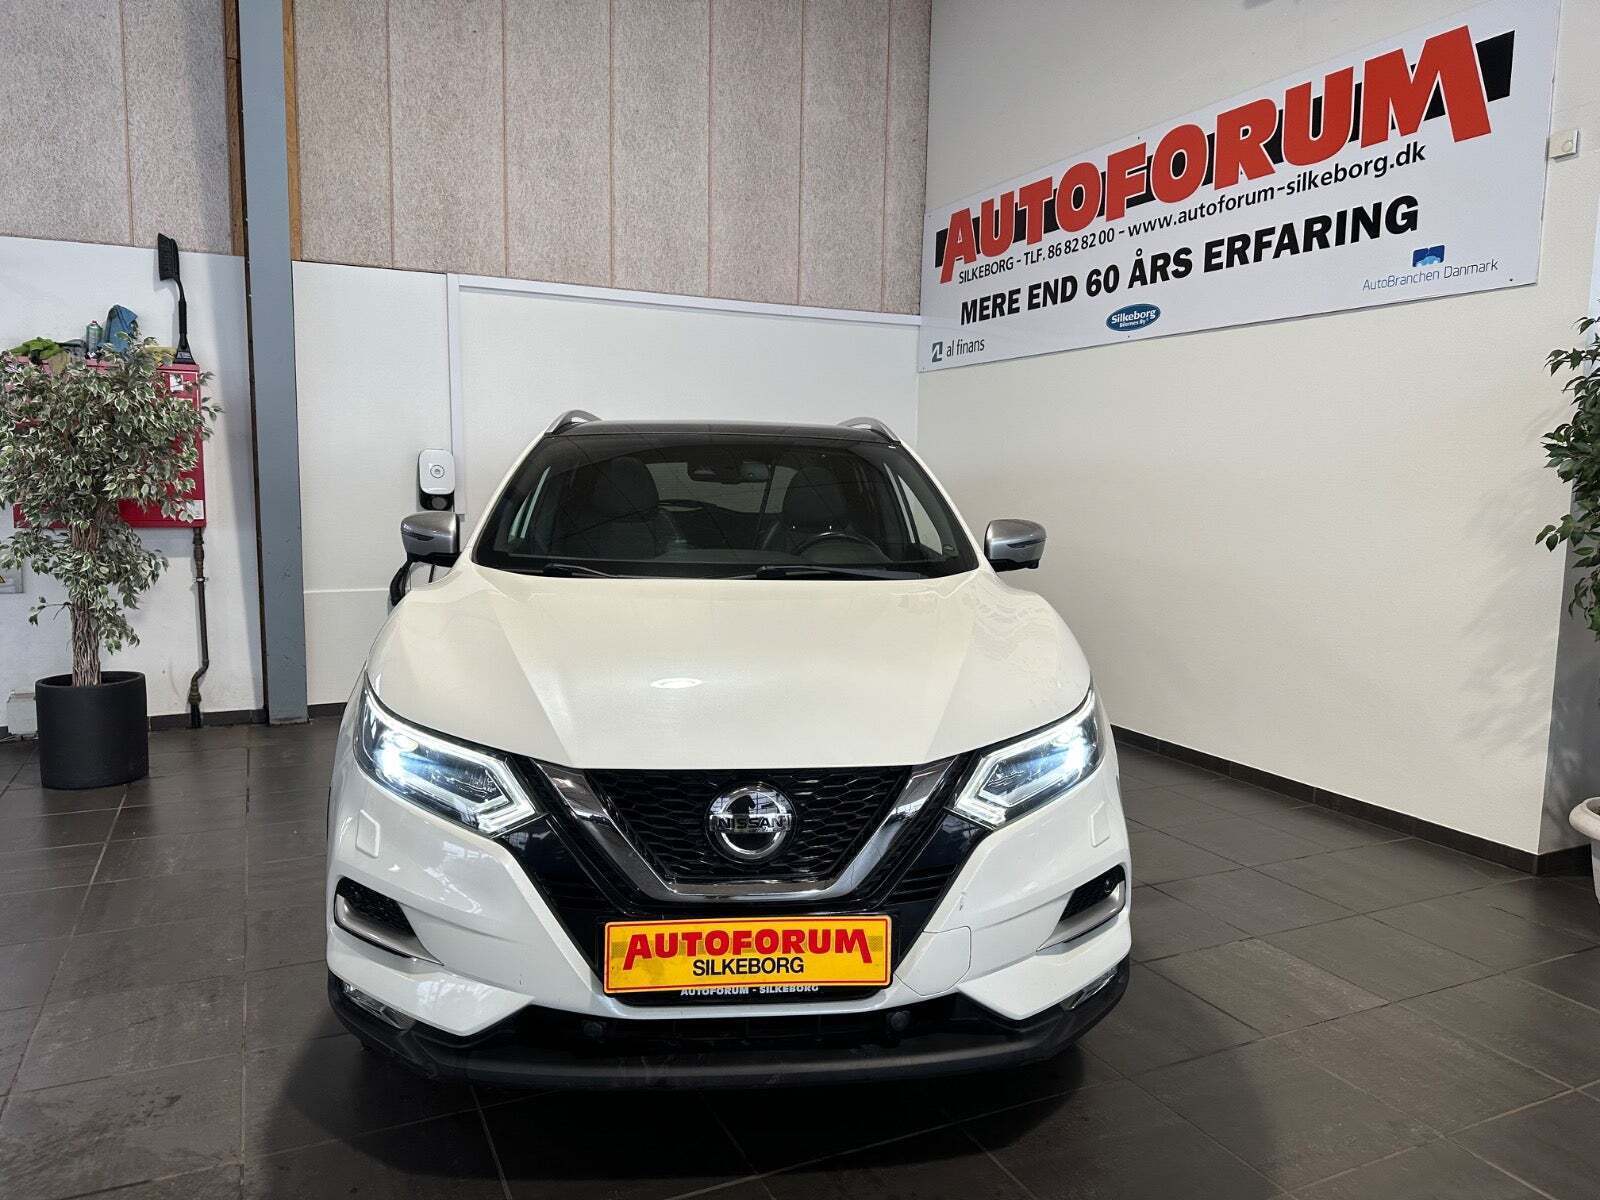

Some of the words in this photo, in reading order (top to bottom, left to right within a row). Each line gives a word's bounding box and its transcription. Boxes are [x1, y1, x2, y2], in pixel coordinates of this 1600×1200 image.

[939, 25, 1492, 284] AUTOFORUM
[958, 257, 1014, 284] SILKEBORG
[1024, 248, 1046, 266] TLF.
[1128, 141, 1426, 237] www.autoforum-silkeborg.dk
[960, 288, 1021, 326] MERE
[1027, 275, 1078, 311] END
[1085, 264, 1120, 298] 60
[1127, 247, 1193, 289] ÅRS
[1203, 195, 1419, 273] ERFARING
[1362, 269, 1440, 291] AutoBranchen
[1443, 258, 1499, 279] Danmark
[1111, 309, 1157, 324] Silkeborg
[946, 341, 954, 357] al
[956, 337, 985, 355] finans
[719, 815, 785, 830] NISSAN
[622, 928, 873, 971] AUTOFORUM
[692, 956, 804, 977] SILKEBORG
[680, 986, 749, 996] AUTOFORUM
[760, 984, 819, 994] SILKEBORG
